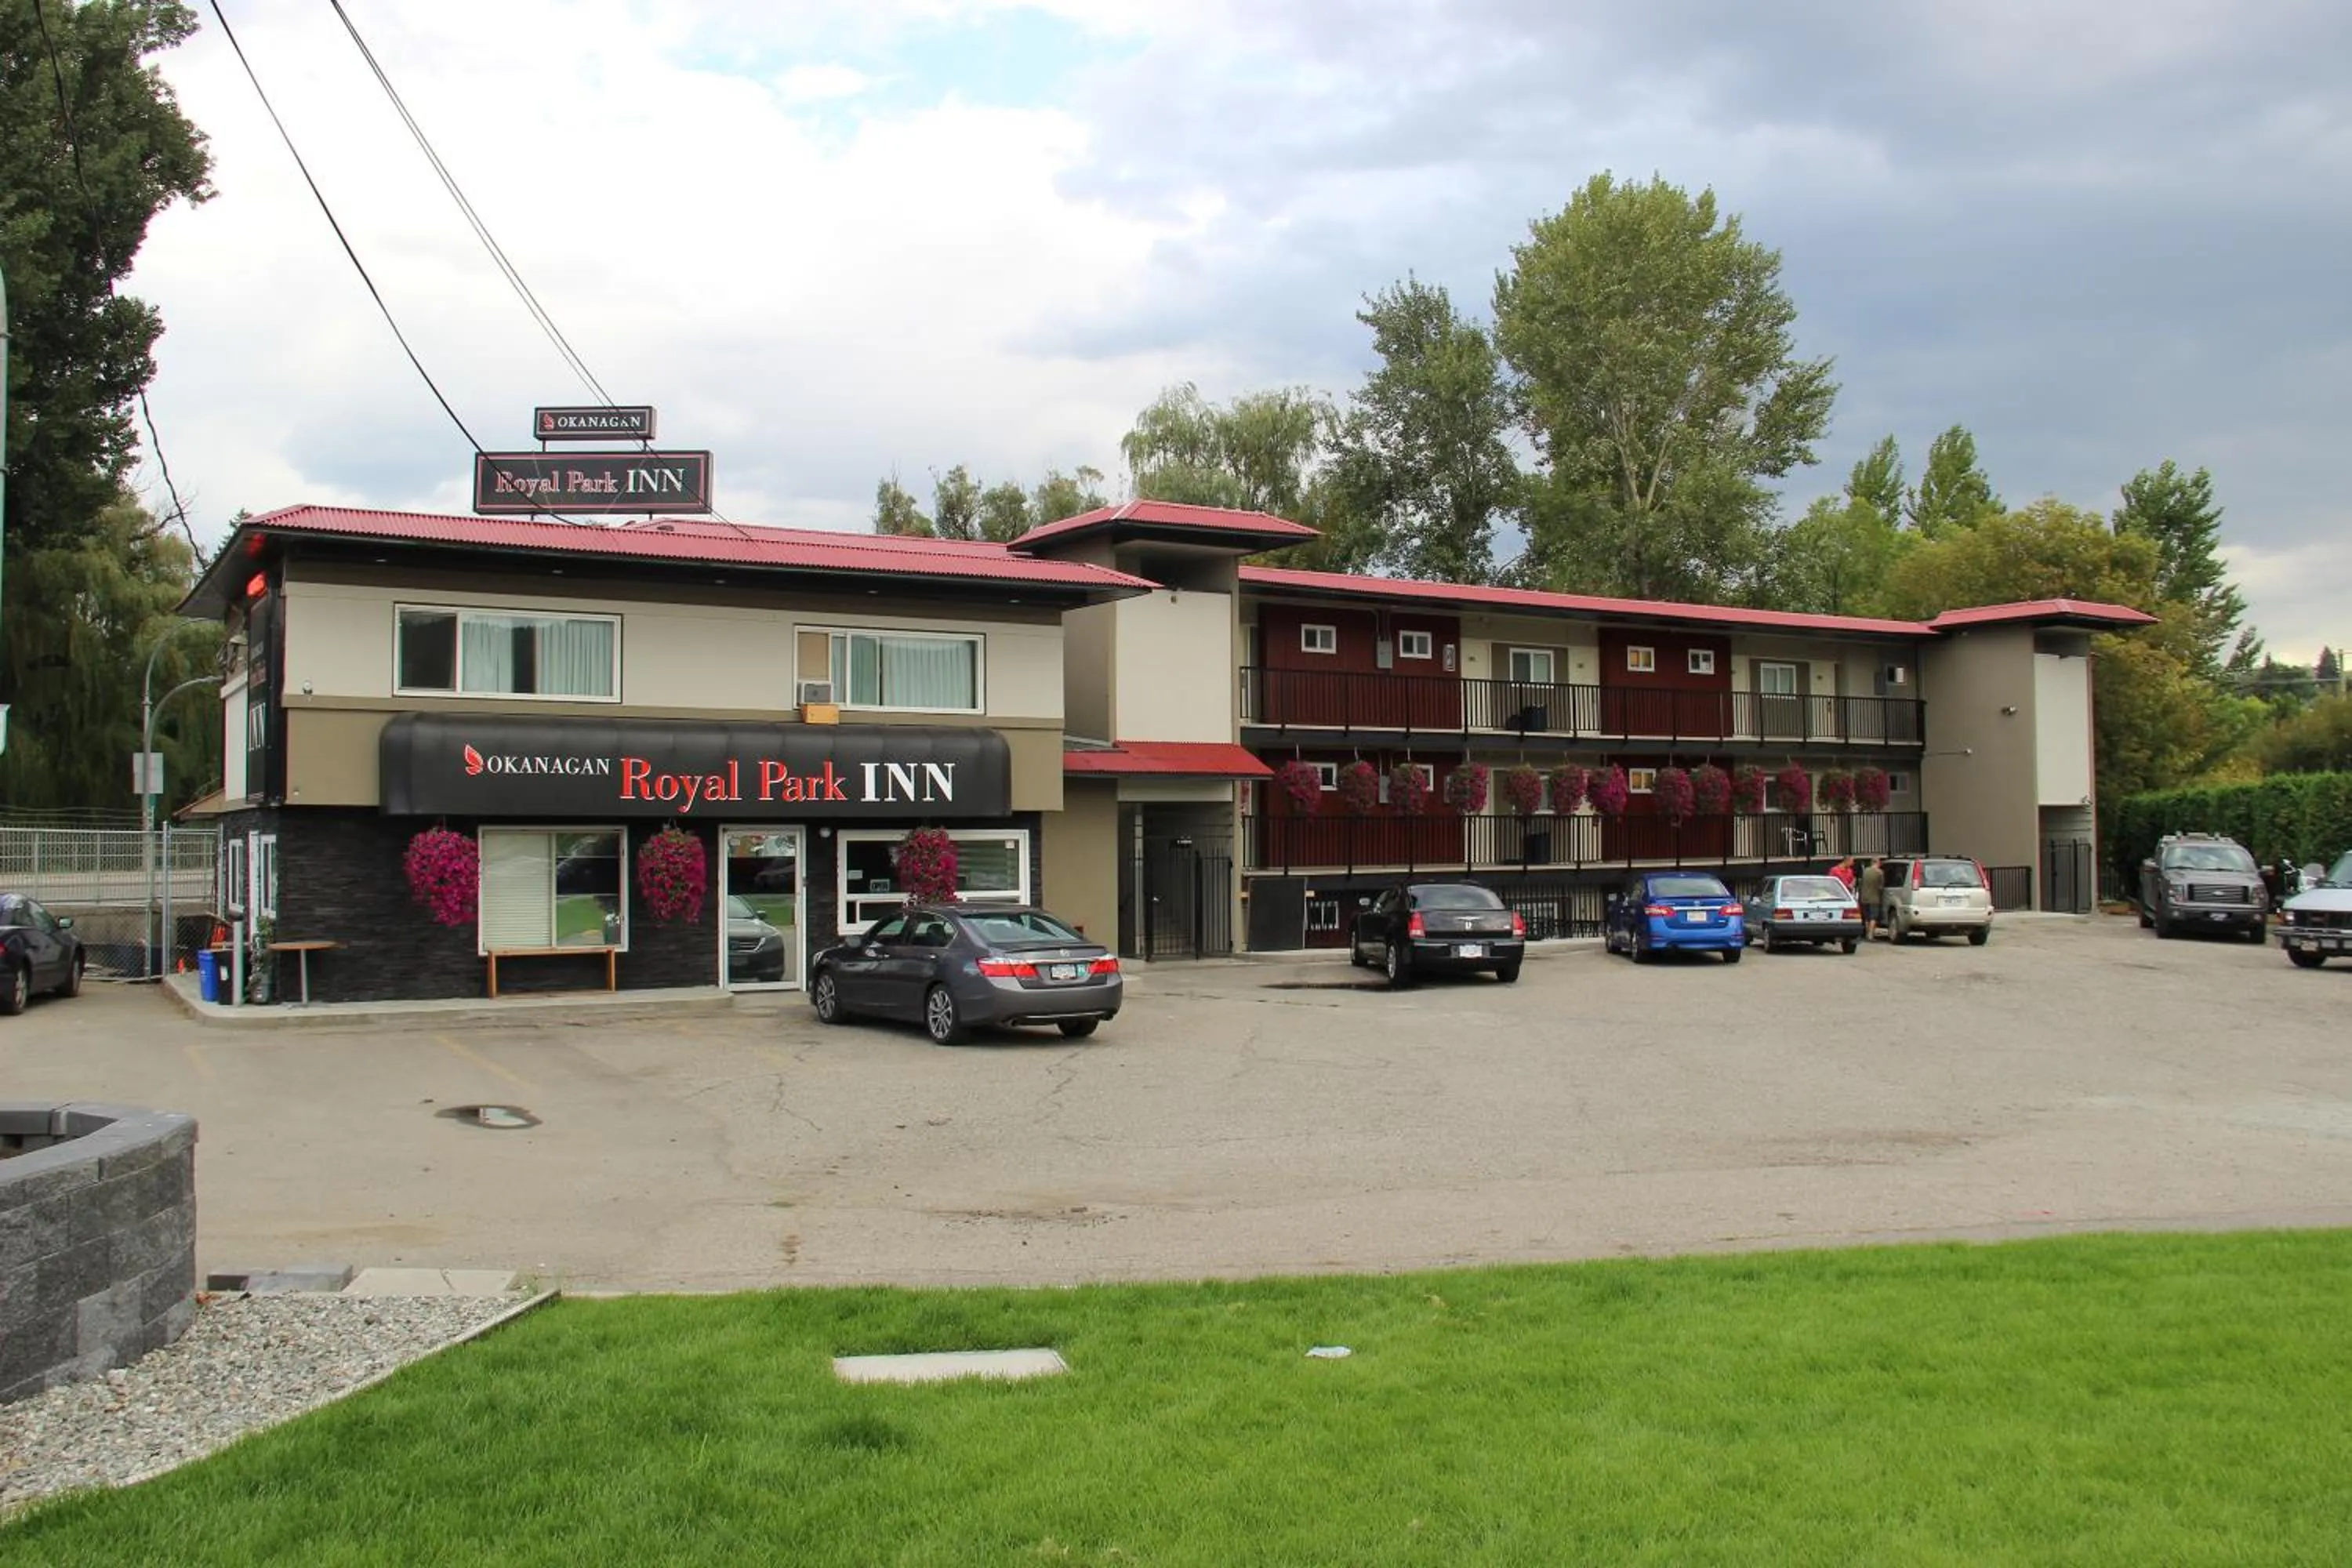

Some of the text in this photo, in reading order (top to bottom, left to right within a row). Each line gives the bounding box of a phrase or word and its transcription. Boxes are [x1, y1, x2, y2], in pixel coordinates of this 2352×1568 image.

[557, 416, 641, 428] OKANAGAN
[495, 468, 685, 497] Royal Park INN
[248, 702, 267, 753] INN
[486, 756, 956, 812] OKANAGAN Royal Park INN
